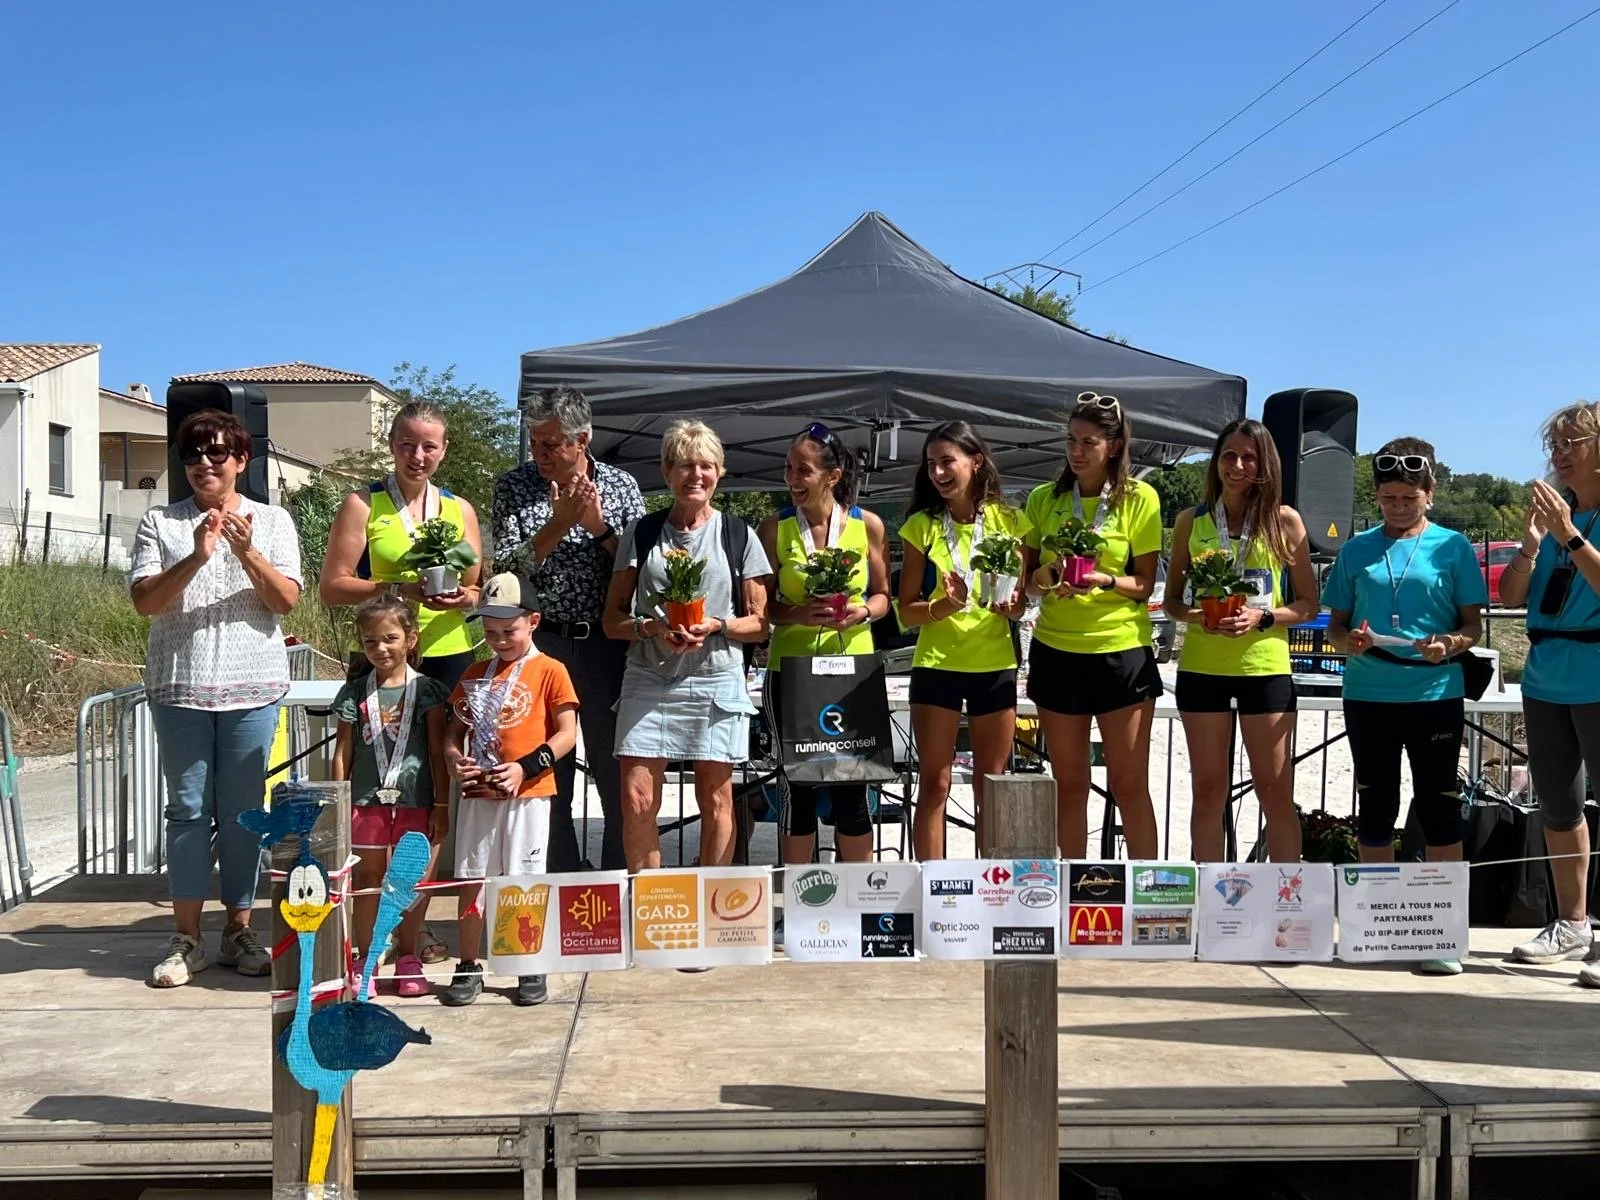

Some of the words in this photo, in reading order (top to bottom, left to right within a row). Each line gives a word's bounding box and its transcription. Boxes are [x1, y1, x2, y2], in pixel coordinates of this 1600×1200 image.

[942, 880, 971, 890] MAMET
[978, 888, 1015, 896] Carrefour
[499, 892, 547, 906] VAUVERT
[983, 895, 1011, 903] market
[636, 904, 690, 920] GARD
[1374, 915, 1434, 923] PARTENAIRES
[959, 923, 979, 931] 2000
[1077, 929, 1122, 937] McDonald's
[1378, 929, 1409, 937] BIP-BIP
[563, 936, 619, 947] Occitanie
[800, 939, 848, 949] GALLICIAN
[1001, 937, 1020, 946] CHEZ
[1391, 943, 1434, 952] Camargue
[1436, 942, 1456, 950] 2024
